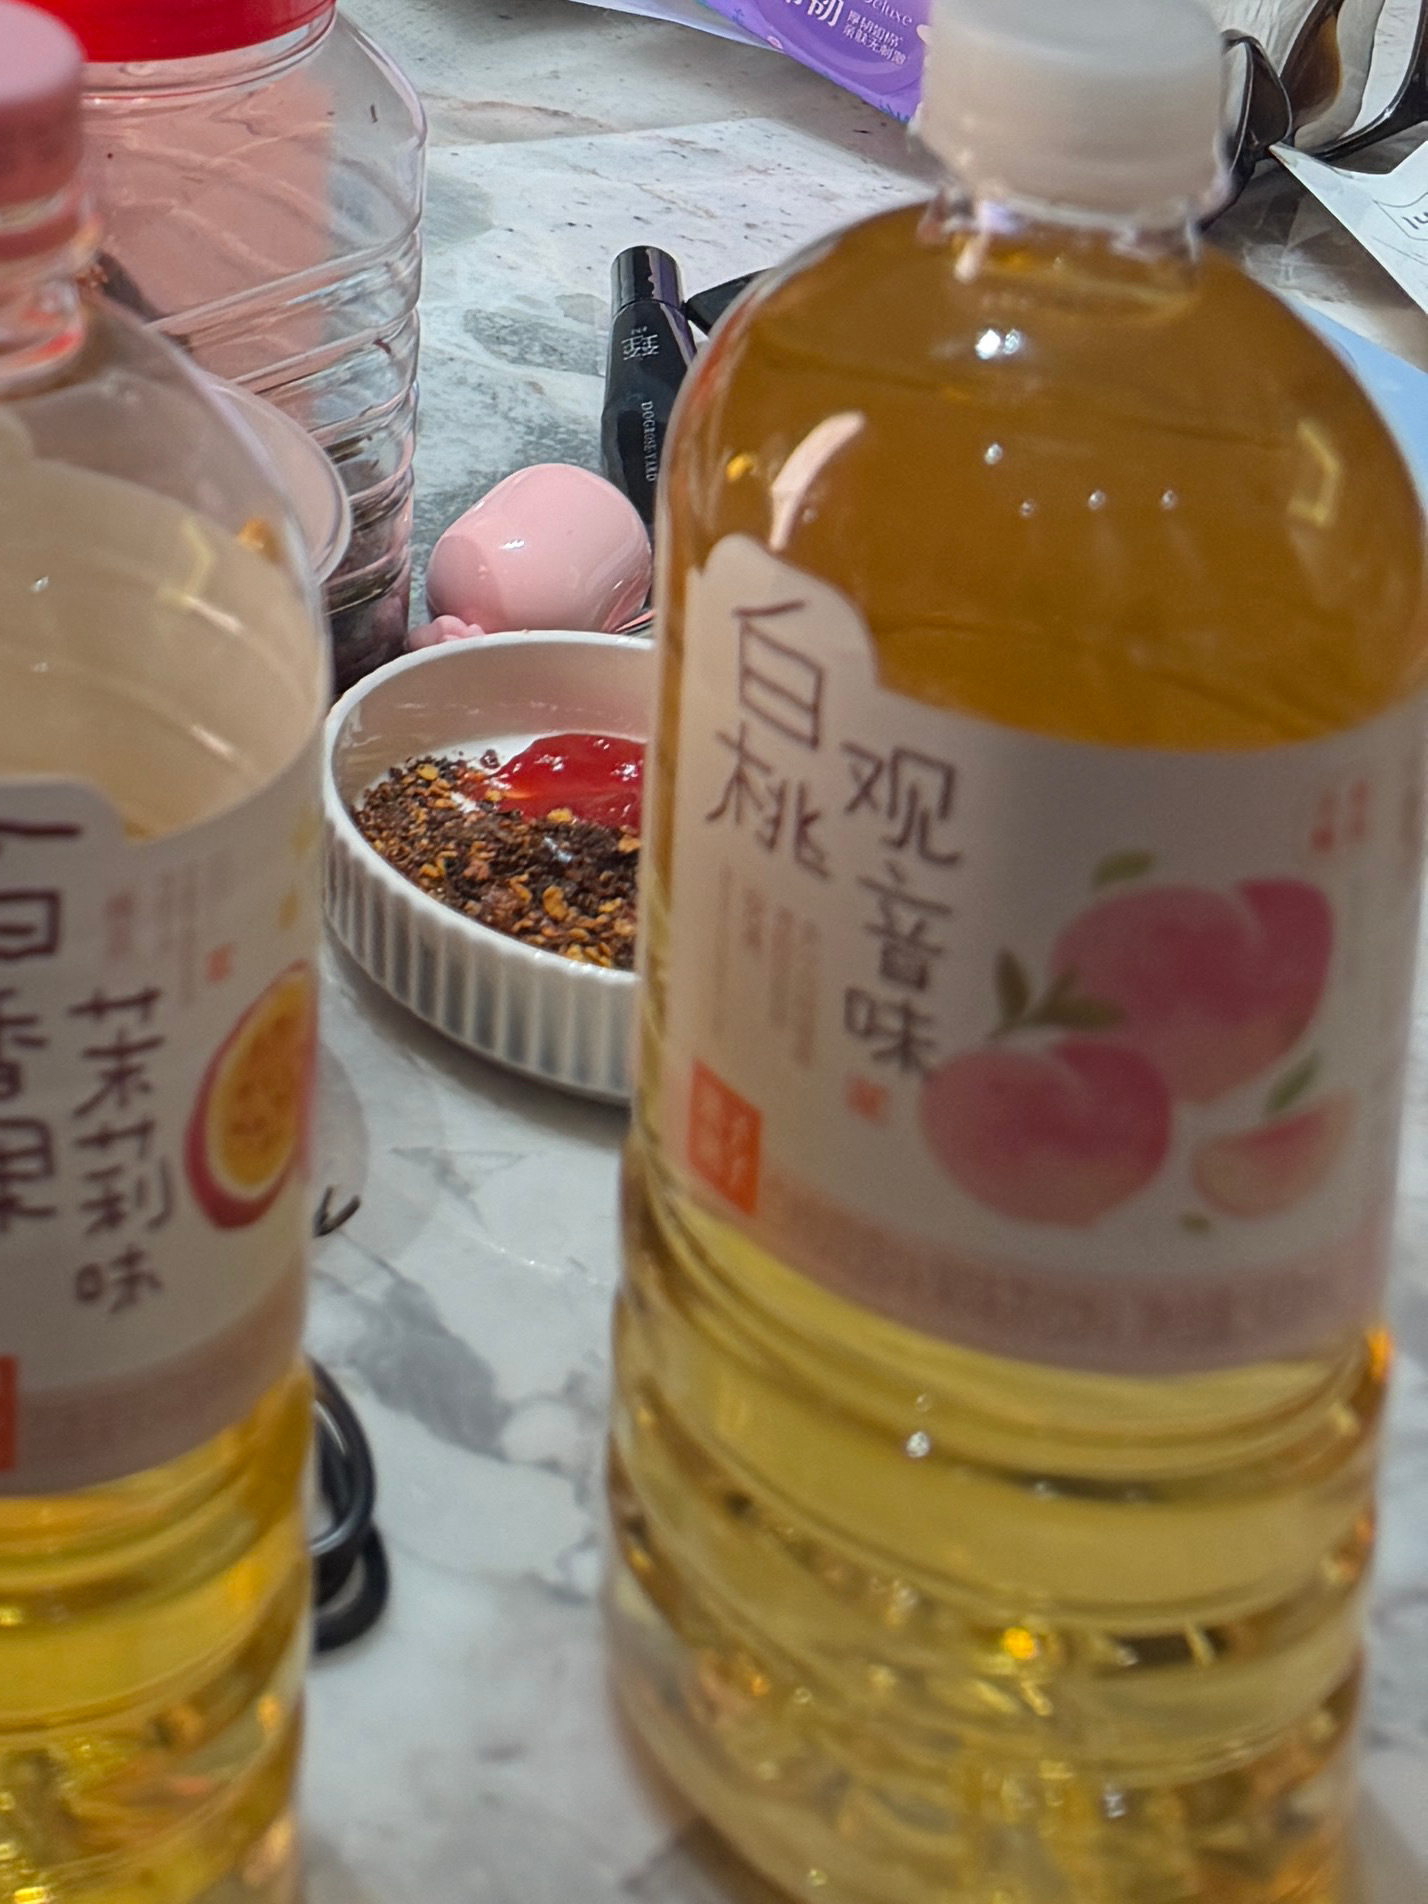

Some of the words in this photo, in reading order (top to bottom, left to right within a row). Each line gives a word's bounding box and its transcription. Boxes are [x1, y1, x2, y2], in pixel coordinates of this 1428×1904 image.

[705, 597, 834, 882] 白桃
[841, 738, 963, 1083] 观音味
[67, 986, 172, 1315] 茉莉味
